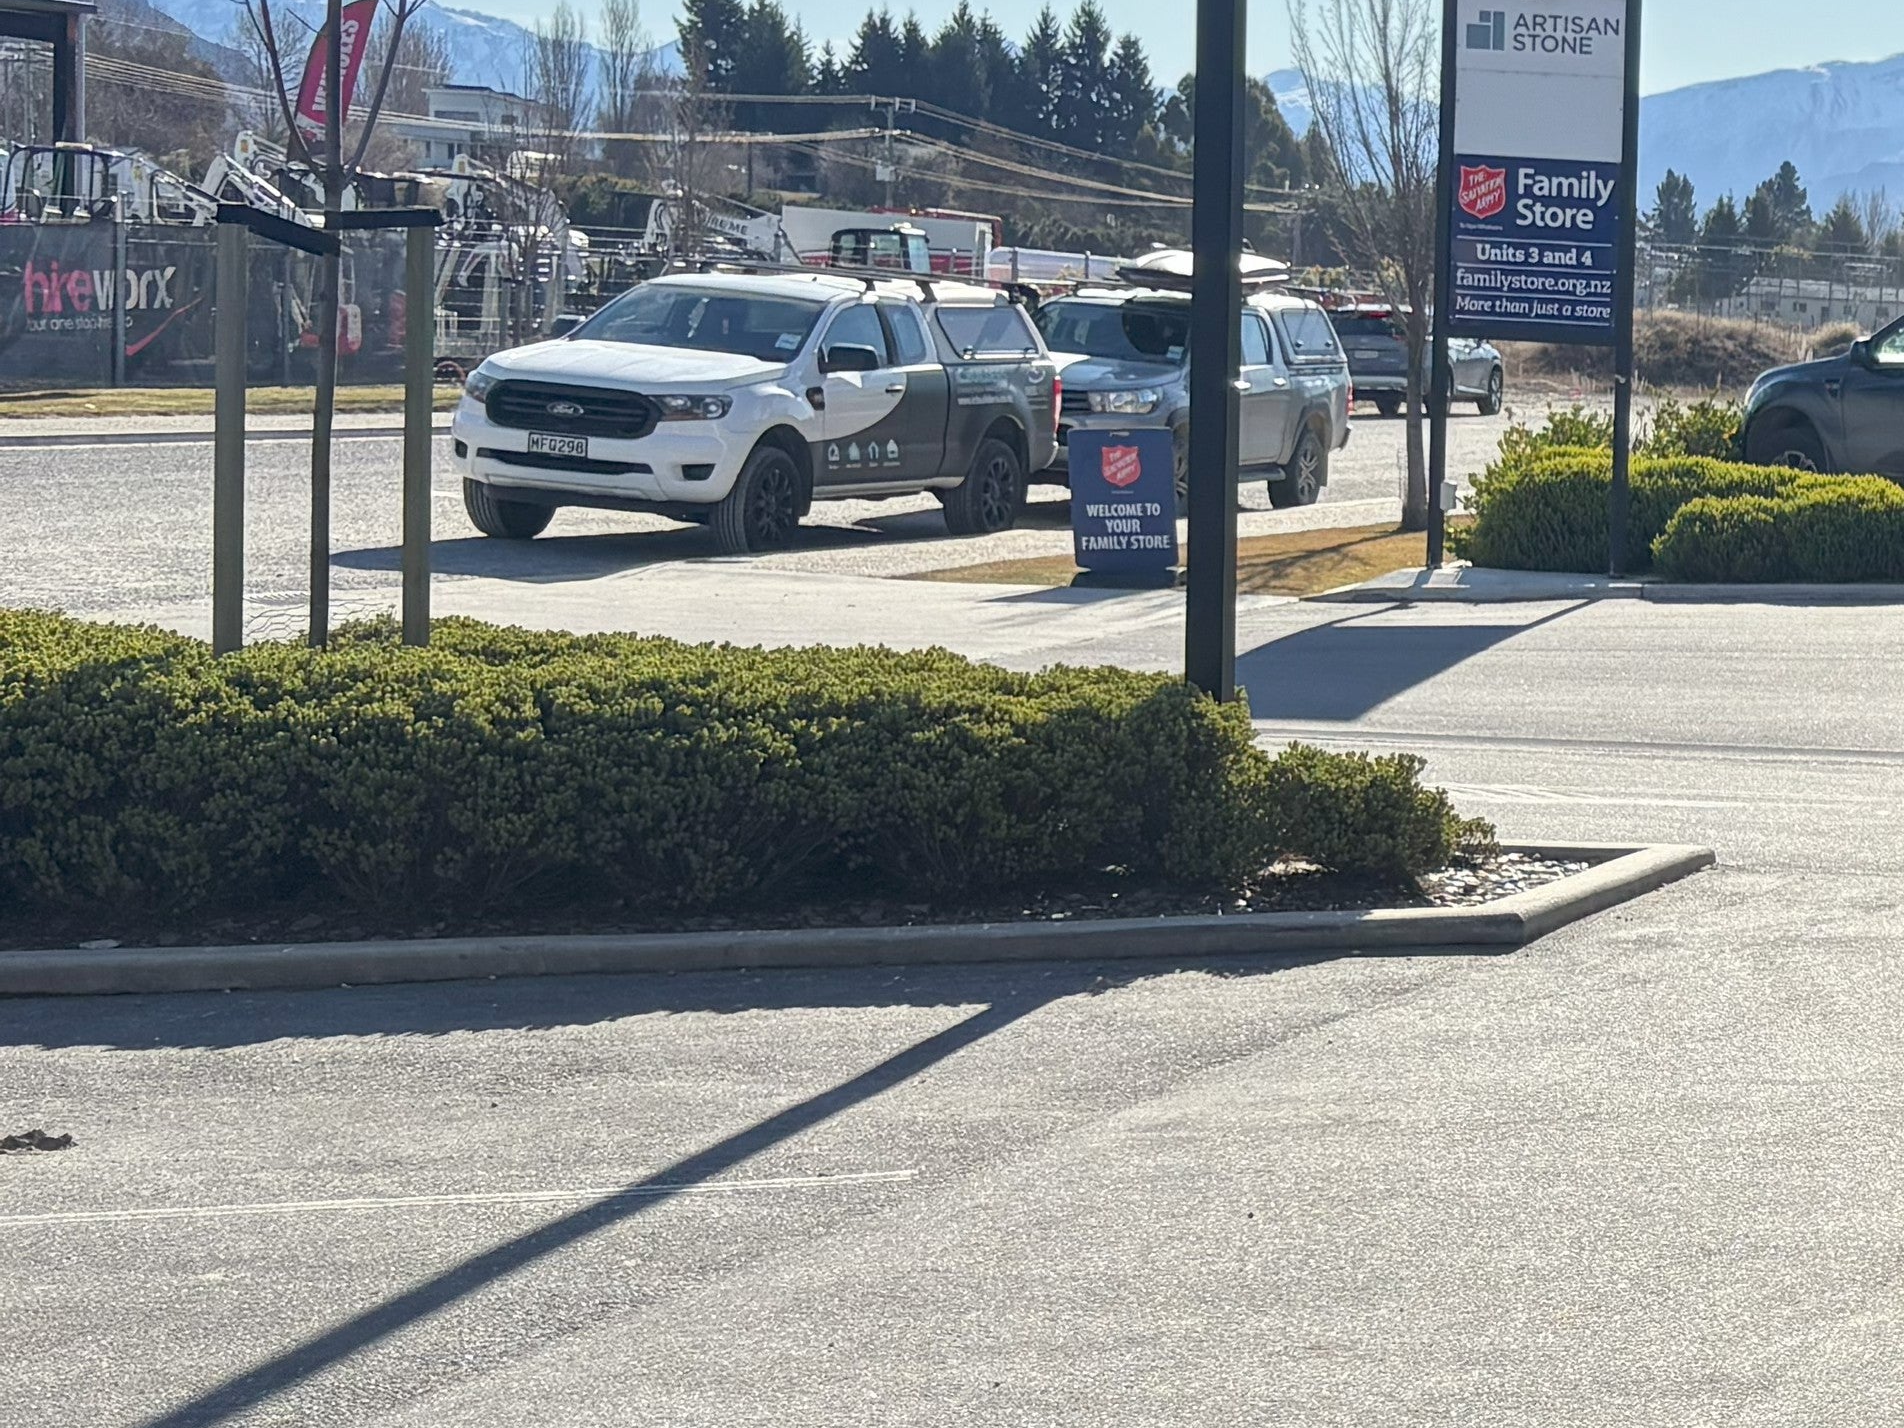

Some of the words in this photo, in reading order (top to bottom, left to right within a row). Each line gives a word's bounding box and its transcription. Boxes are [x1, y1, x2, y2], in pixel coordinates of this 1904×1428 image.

[1513, 12, 1620, 36] ARTISAN
[1512, 32, 1594, 55] STONE
[1517, 167, 1615, 207] Family
[1516, 198, 1595, 230] Store
[1475, 243, 1525, 263] Units
[1528, 247, 1540, 264] 3
[1542, 248, 1577, 266] and
[1580, 250, 1593, 266] 4
[1455, 268, 1612, 296] familystore.org.nz
[1455, 295, 1493, 311] More
[1494, 297, 1529, 314] than
[1531, 299, 1559, 317] just
[1562, 305, 1572, 316] a
[1574, 304, 1611, 318] store
[531, 436, 584, 455] MFQ298
[1086, 503, 1144, 518] WELCOME
[1145, 502, 1161, 516] TO
[1105, 519, 1141, 534] YOUR
[1081, 536, 1129, 551] FAMILY
[1129, 535, 1171, 549] STORE
